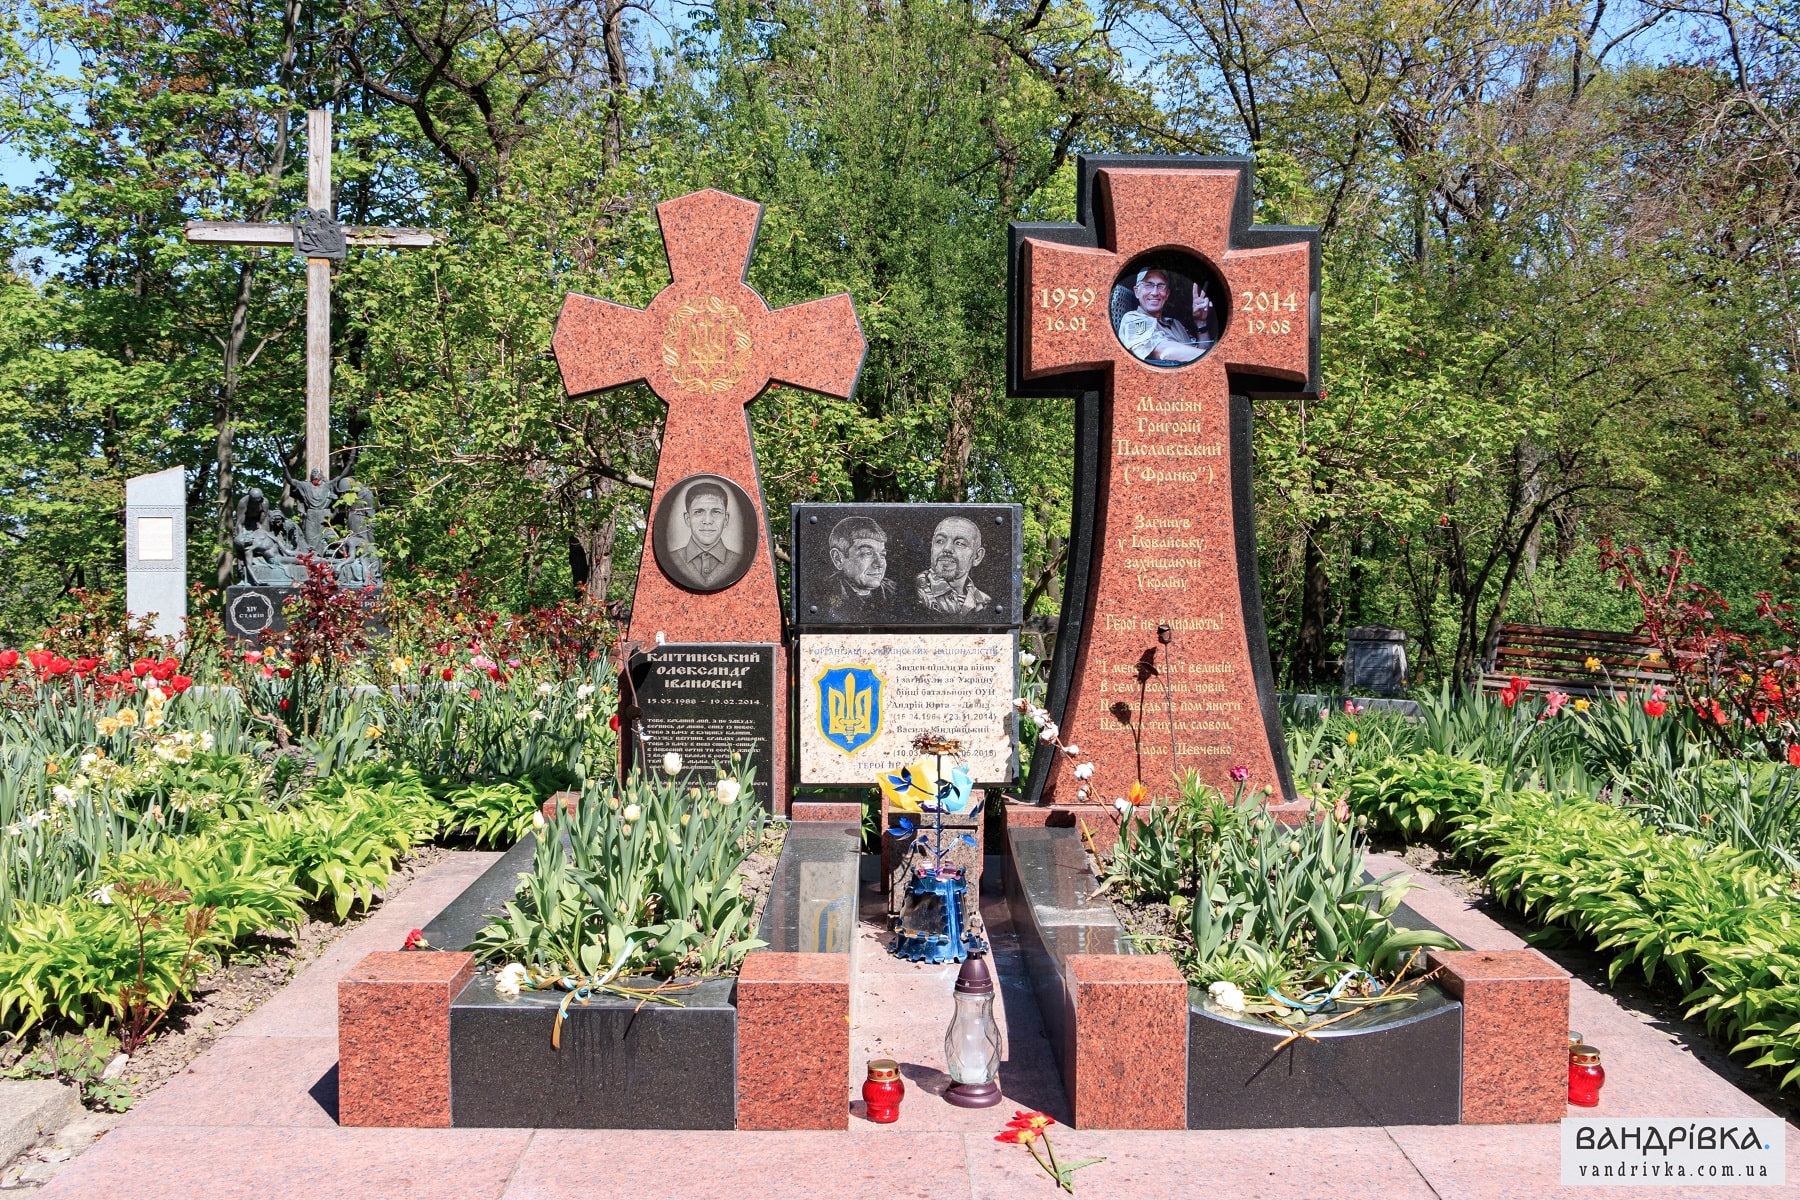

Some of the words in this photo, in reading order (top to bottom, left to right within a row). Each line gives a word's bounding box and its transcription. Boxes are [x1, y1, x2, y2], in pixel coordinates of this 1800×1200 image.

[1040, 288, 1096, 309] 1959
[1241, 291, 1298, 312] 2014
[1046, 316, 1088, 332] 16.01
[1247, 319, 1291, 335] 19.08
[1136, 396, 1203, 415] Маркіян
[1137, 417, 1201, 436] Григорій
[1116, 439, 1222, 457] Паславський
[1135, 514, 1191, 532] Загинув
[1118, 538, 1127, 551] у
[1131, 534, 1208, 552] Іловайську,
[1124, 557, 1201, 572] захищаючи
[1136, 574, 1189, 592] Україну
[1105, 613, 1137, 634] Герої
[1141, 619, 1155, 631] не
[647, 652, 761, 663] КЛІТИНСЬКИЙ
[656, 666, 750, 677] ОЛЕКСАНДР
[664, 679, 743, 689] ІВАНОВИЧ
[975, 688, 996, 696] ОУН
[1100, 679, 1108, 692] В
[1174, 742, 1232, 755] Шевченко
[858, 761, 885, 769] ГЕРОЇ
